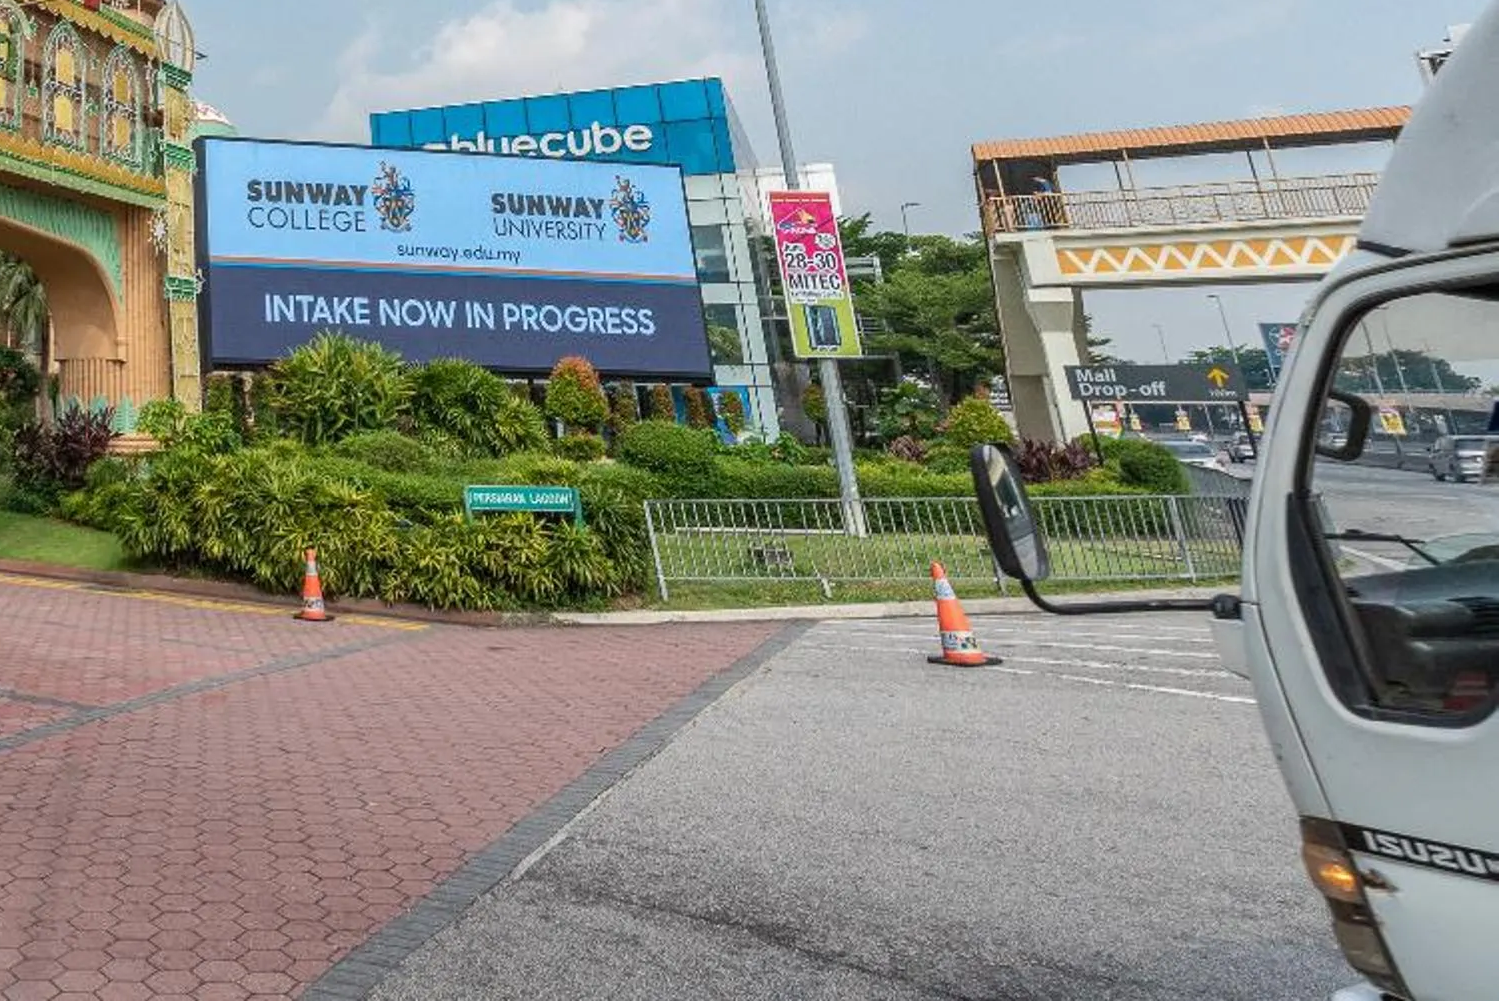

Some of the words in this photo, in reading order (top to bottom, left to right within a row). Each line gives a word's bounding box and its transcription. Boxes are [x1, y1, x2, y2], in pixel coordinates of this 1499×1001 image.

[451, 121, 653, 157] bluecube
[247, 179, 368, 206] SUNWAY
[491, 193, 605, 220] SUNWAY
[248, 207, 366, 232] COLLEGE
[493, 217, 606, 241] UNIVERSITY
[397, 244, 521, 264] sunway.edu.my
[785, 252, 837, 269] 28-30
[789, 273, 840, 290] MITEC
[264, 294, 371, 326] INTAKE
[379, 299, 458, 329] NOW
[465, 301, 495, 330] IN
[503, 304, 656, 335] PROGRESS
[1075, 368, 1116, 383] Mall
[1078, 381, 1166, 398] Drop-off
[1363, 830, 1488, 875] ISUZU
